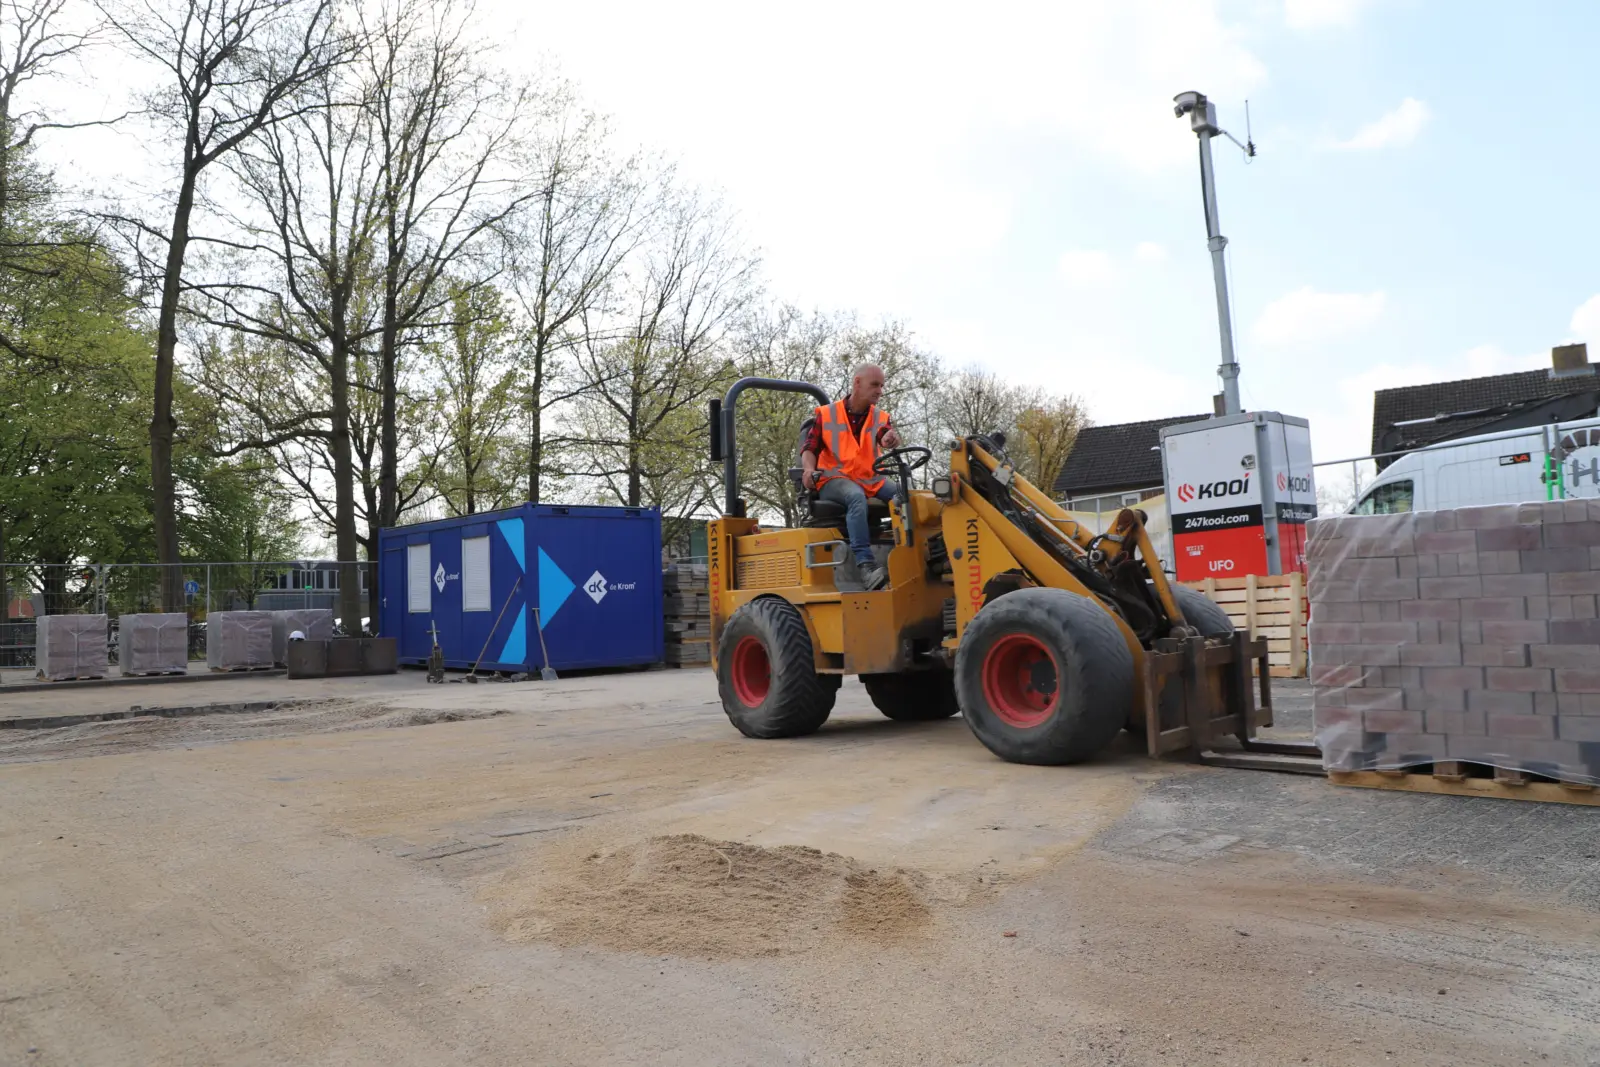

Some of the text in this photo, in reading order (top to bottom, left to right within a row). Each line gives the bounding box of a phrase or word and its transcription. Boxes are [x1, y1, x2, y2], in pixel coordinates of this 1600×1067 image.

[1185, 513, 1249, 528] 247kooi.com
[1209, 559, 1234, 571] UFO
[617, 582, 635, 590] Krom
